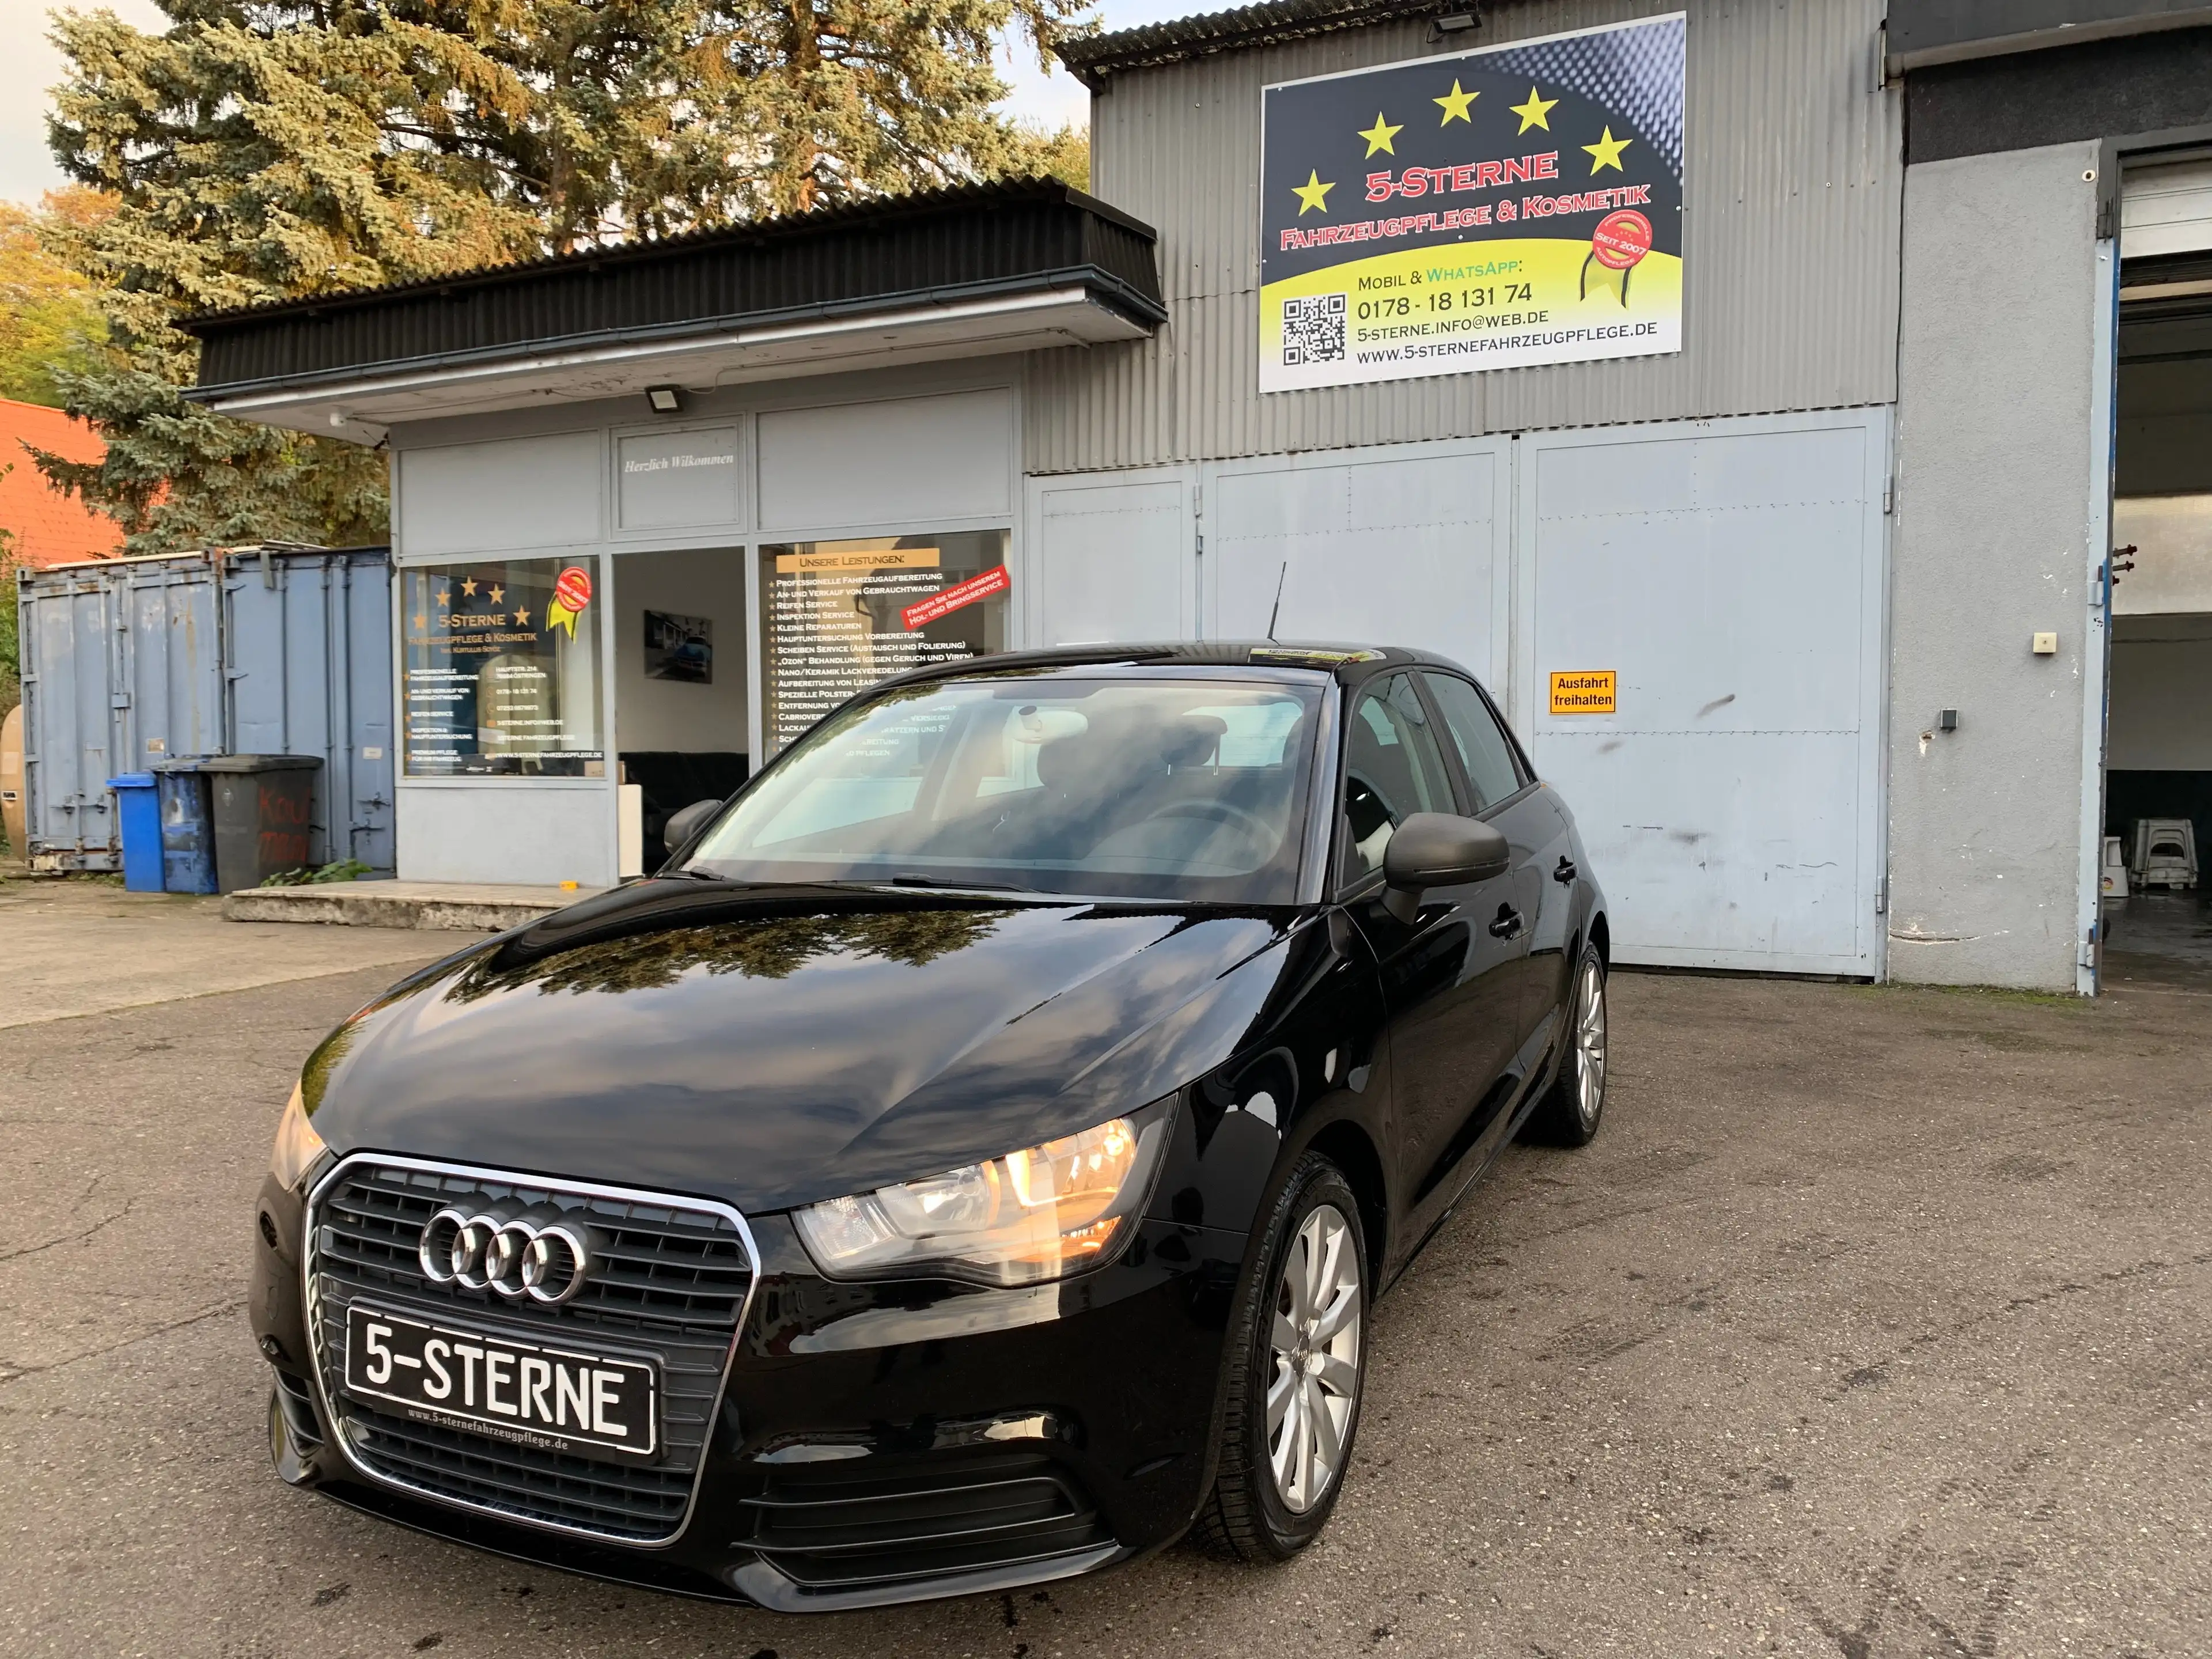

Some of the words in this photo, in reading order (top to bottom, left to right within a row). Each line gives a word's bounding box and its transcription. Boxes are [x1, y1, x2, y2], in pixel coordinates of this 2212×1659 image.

[1365, 150, 1558, 202] 5-STERNE
[1280, 204, 1491, 251] FAHRZEUGPFLEGE
[1497, 199, 1517, 222] &
[1522, 184, 1651, 219] KOSMETIK
[1595, 232, 1619, 246] SEIT
[1619, 241, 1647, 255] 2007
[1358, 276, 1406, 291] MOBIL
[1410, 271, 1422, 284] &
[1358, 297, 1410, 320] 0178
[1429, 292, 1452, 312] 18
[1461, 287, 1494, 308] 131
[1504, 283, 1532, 303] 74
[1357, 310, 1549, 342] 5-STERNE.INFO@WEB.DE
[1357, 322, 1657, 364] WWW.5-STERNEFAHRZEUGPFLEGE.DE
[624, 458, 668, 472] Herzlich
[800, 558, 839, 567] UNSERE
[842, 555, 905, 566] LEISTUNGEN:
[776, 578, 842, 587] PROFESSIONELLE
[843, 573, 943, 584] FAHRZEUGAUFBEREITUNG
[863, 585, 940, 594] GEBRAUCHTWAGEN
[906, 600, 935, 616] FRAGEN
[935, 596, 948, 604] SIE
[948, 586, 967, 599] NACH
[967, 571, 1001, 590] UNSEREM
[908, 614, 929, 626] HOL-
[928, 605, 945, 617] UND
[945, 579, 1003, 609] BRINGSERVICE
[438, 613, 506, 628] 5-STERNE
[806, 623, 862, 631] REPARATUREN
[485, 634, 492, 642] &
[493, 632, 537, 642] KOSMETIK
[777, 634, 863, 643] HAUPTUNTERSUCHUNG
[865, 632, 925, 640] VORBEREITUNG
[850, 643, 899, 652] (AUSTAUSCH
[918, 641, 966, 650] FOLIERUNG)
[862, 655, 892, 663] (GEGEN
[892, 654, 925, 662] GERUCH
[1558, 677, 1608, 688] Ausfahrt
[1554, 694, 1612, 705] freihalten
[366, 1323, 627, 1437] 5-STERNE
[408, 1408, 569, 1450] www.5-sternefahrzeugpflege.de
